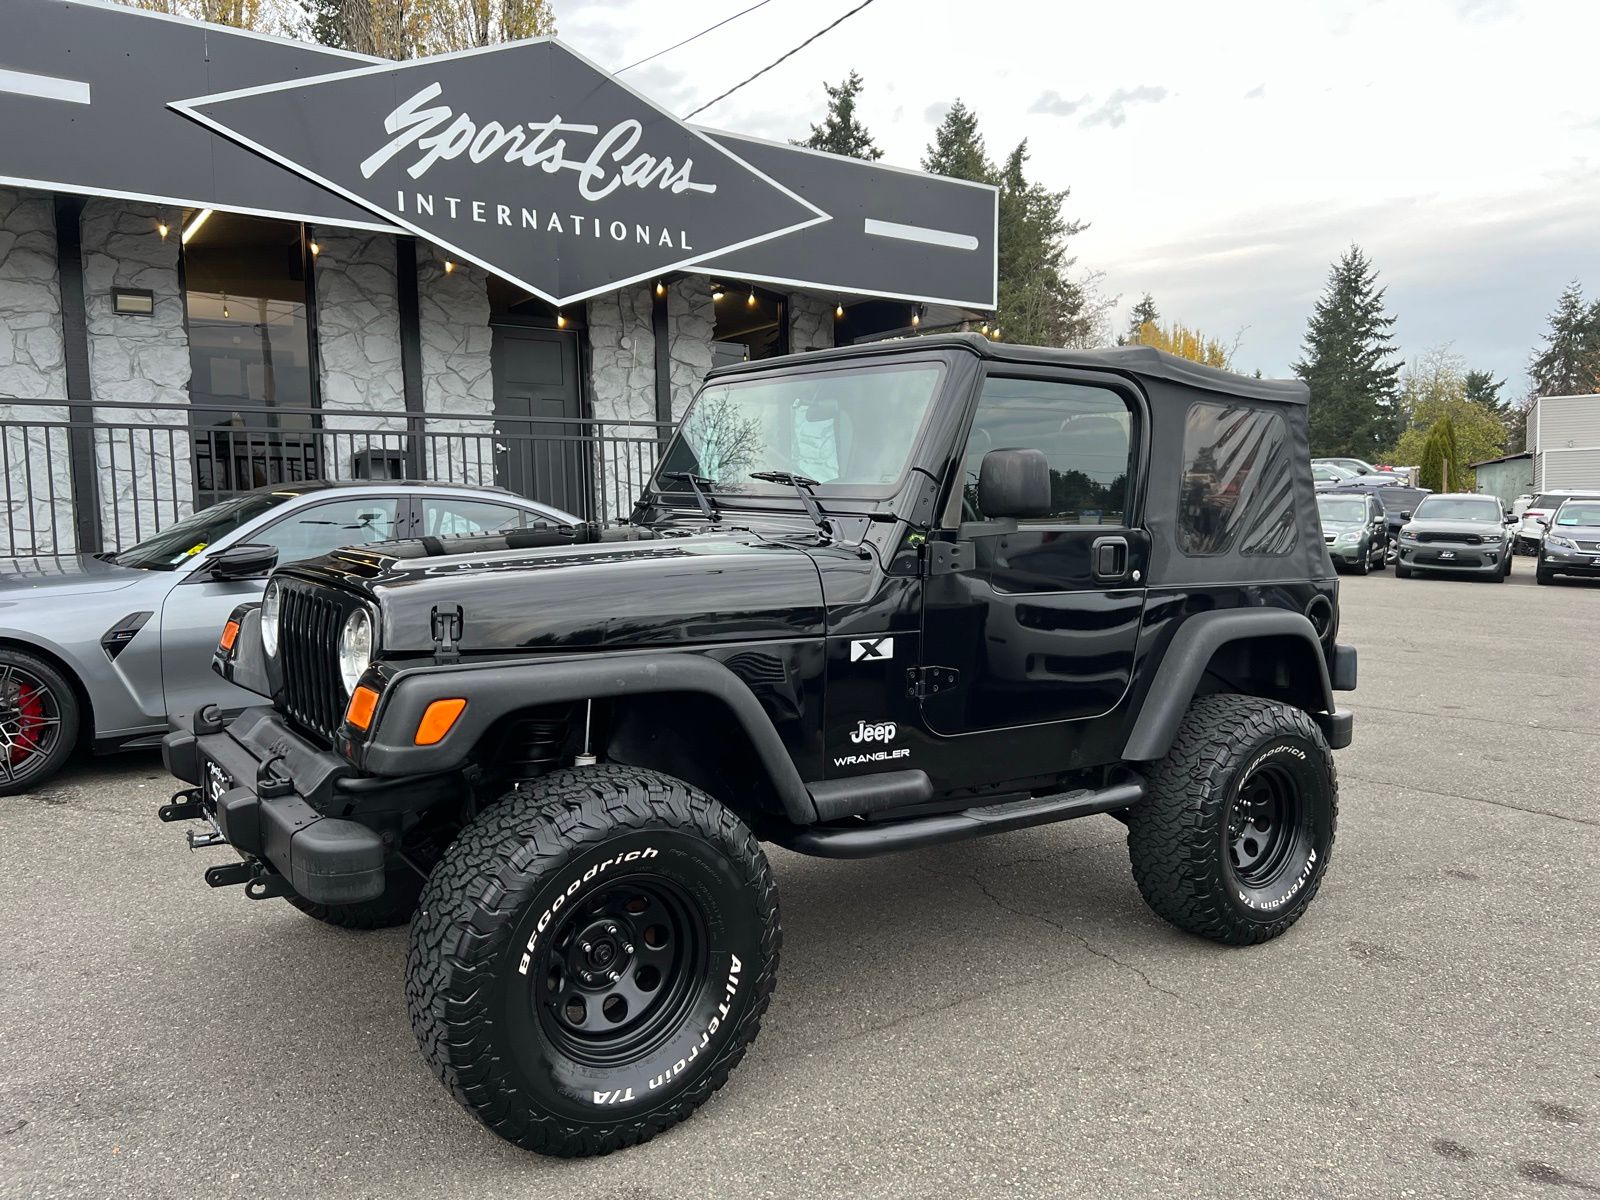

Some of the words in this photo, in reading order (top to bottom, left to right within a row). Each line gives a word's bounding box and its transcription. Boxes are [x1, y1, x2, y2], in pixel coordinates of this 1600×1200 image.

[360, 82, 599, 180] Sports
[576, 119, 717, 202] Cars
[397, 189, 693, 251] INTERNATIONAL
[833, 748, 911, 767] WRANGLER
[850, 720, 897, 744] Jeep
[1260, 848, 1317, 910] All-Terrain
[518, 846, 659, 976] BFGoodrich
[648, 954, 743, 1090] All-Terrain
[592, 1087, 636, 1105] T/A
